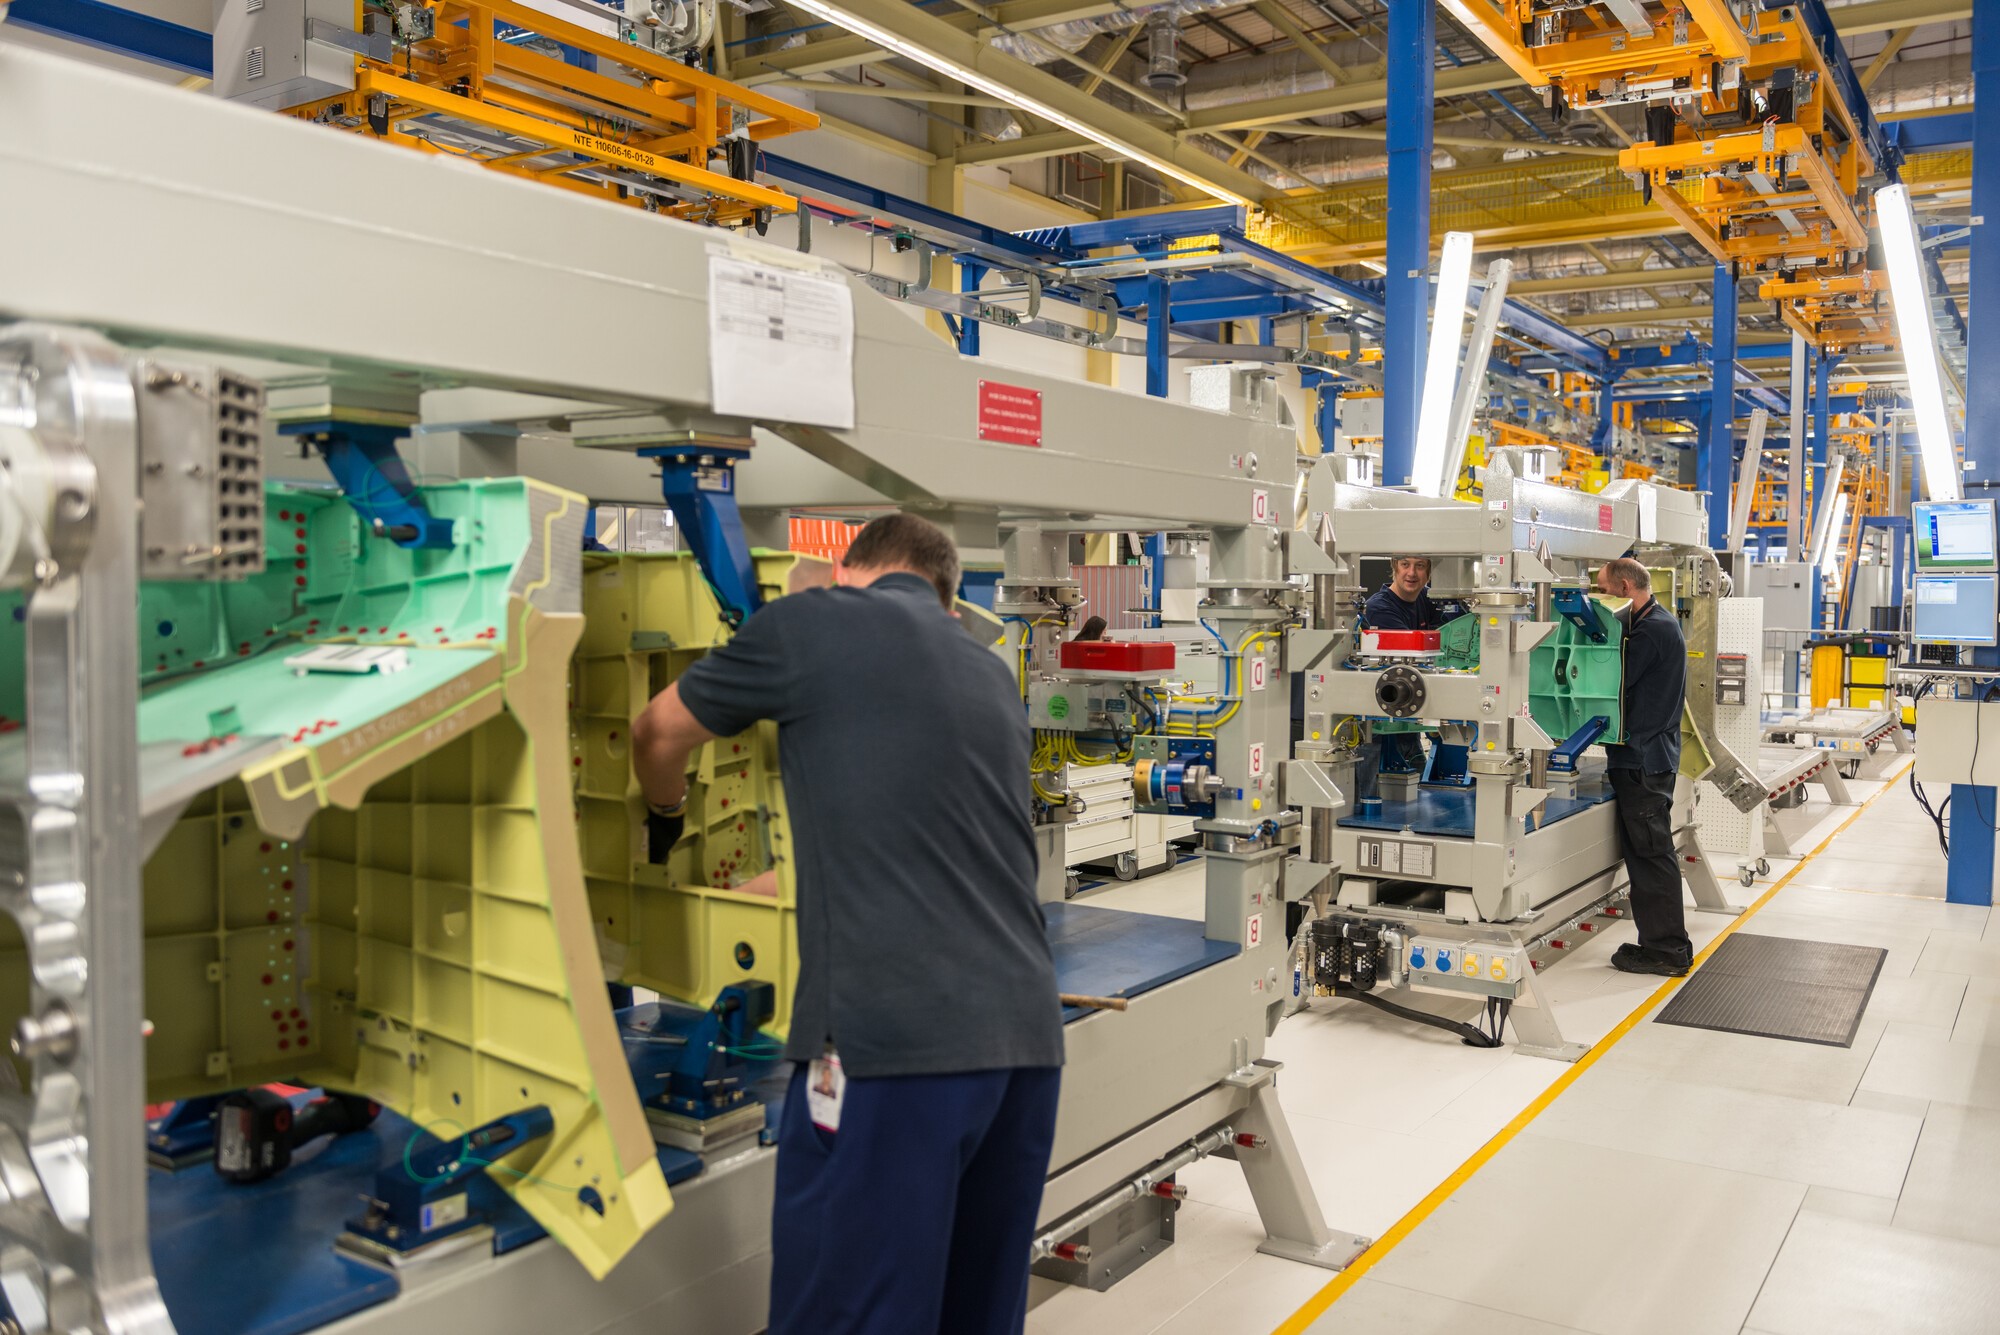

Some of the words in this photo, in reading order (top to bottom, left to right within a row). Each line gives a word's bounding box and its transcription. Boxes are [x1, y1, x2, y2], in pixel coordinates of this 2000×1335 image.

[574, 134, 591, 147] NTE
[595, 141, 655, 166] 110606-16-01-28
[1253, 748, 1260, 772] B
[1250, 919, 1258, 943] B
